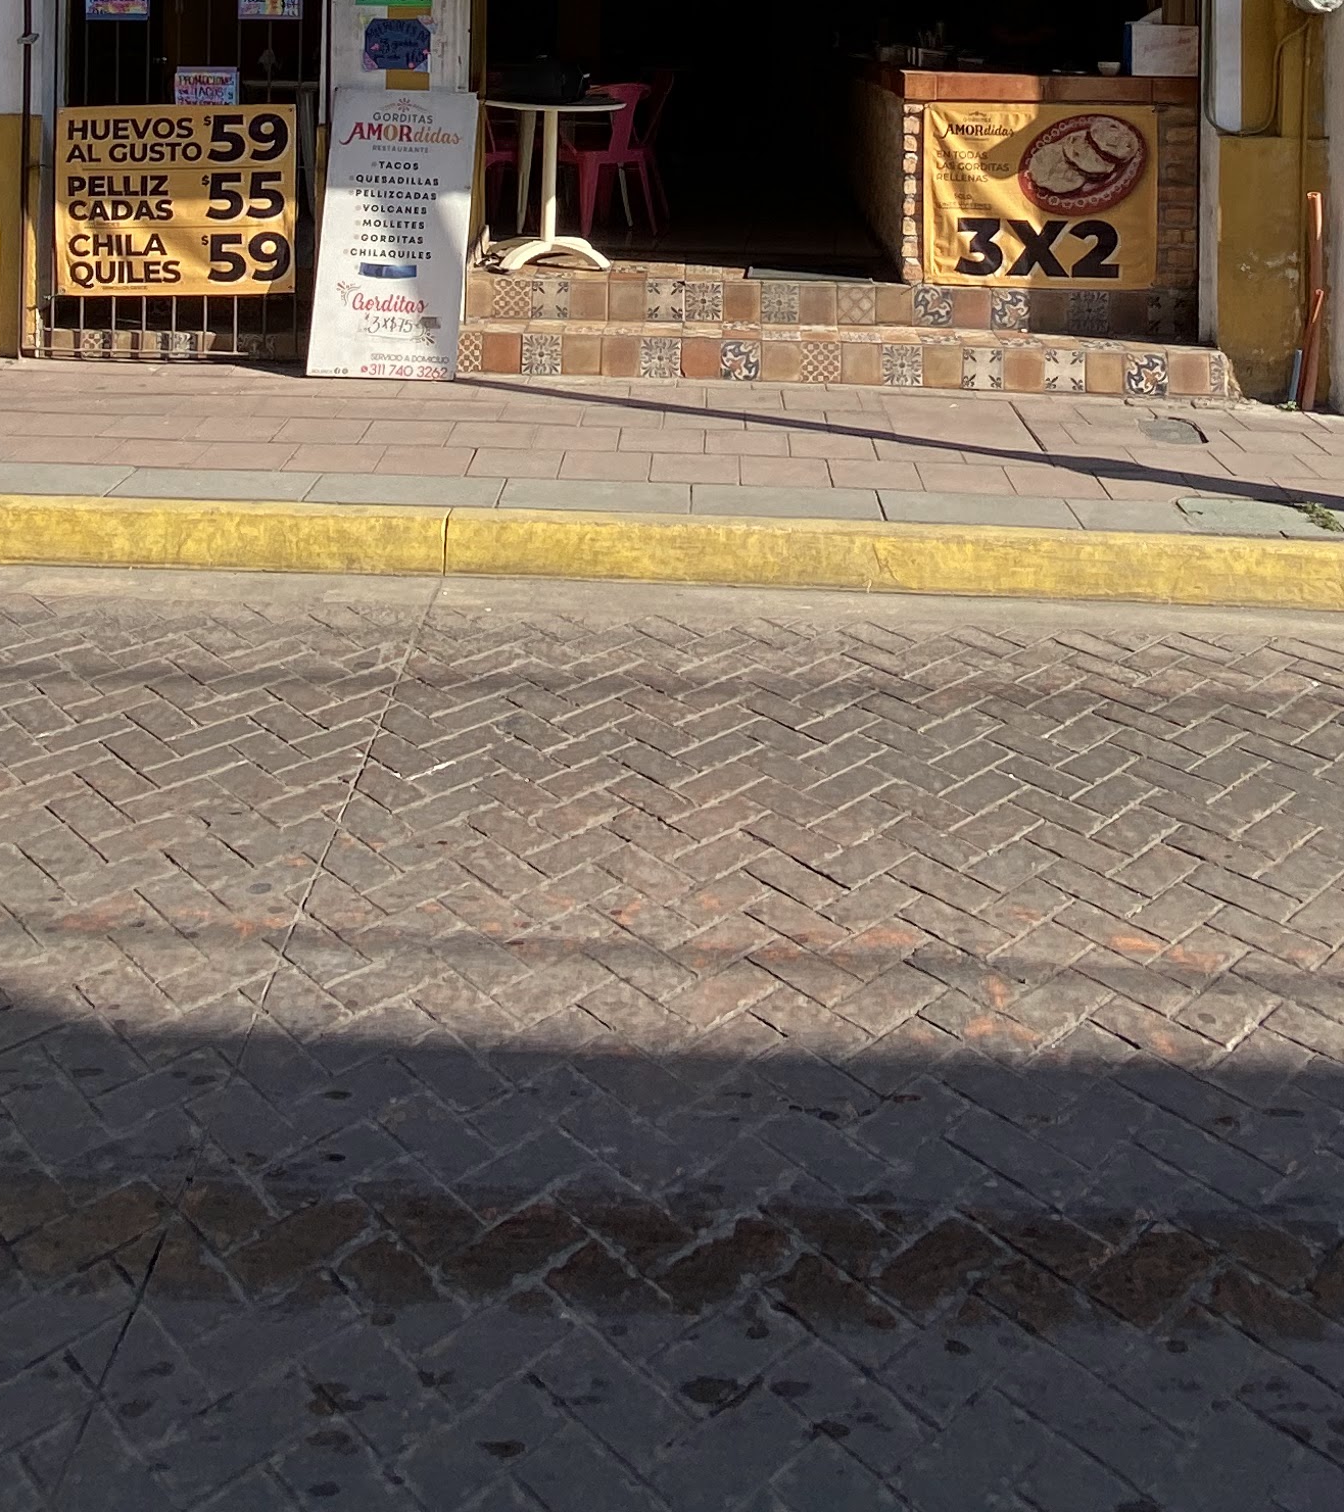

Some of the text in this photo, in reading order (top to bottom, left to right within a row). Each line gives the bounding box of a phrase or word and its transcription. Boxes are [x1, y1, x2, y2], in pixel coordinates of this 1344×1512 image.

[373, 112, 433, 124] GORDITAS
[67, 117, 194, 140] HUEVOS
[339, 121, 462, 146] AMORdidas
[66, 142, 202, 163] AL GUSTO
[954, 150, 989, 159] TODAS
[378, 160, 419, 170] TACOS
[936, 162, 1010, 172] LAS GORDITAS
[356, 174, 439, 186] QUESADILLAS
[936, 172, 989, 182] RELLENAS
[67, 175, 169, 197] PELLIZ
[355, 189, 437, 201] PELLIZCADAS
[68, 199, 174, 221] CADAS
[362, 204, 427, 215] VOLCANES
[362, 219, 425, 229] MOLLETES
[68, 233, 167, 257] CHILA
[361, 234, 424, 244] GORDITAS
[350, 248, 432, 259] CHILAQUILES
[953, 217, 1120, 278] 3X2
[69, 260, 182, 288] QUILES
[352, 292, 429, 314] Gorditas
[370, 353, 403, 362] SERVICIO
[403, 354, 410, 362] A
[368, 363, 448, 379] 311 740 3262
